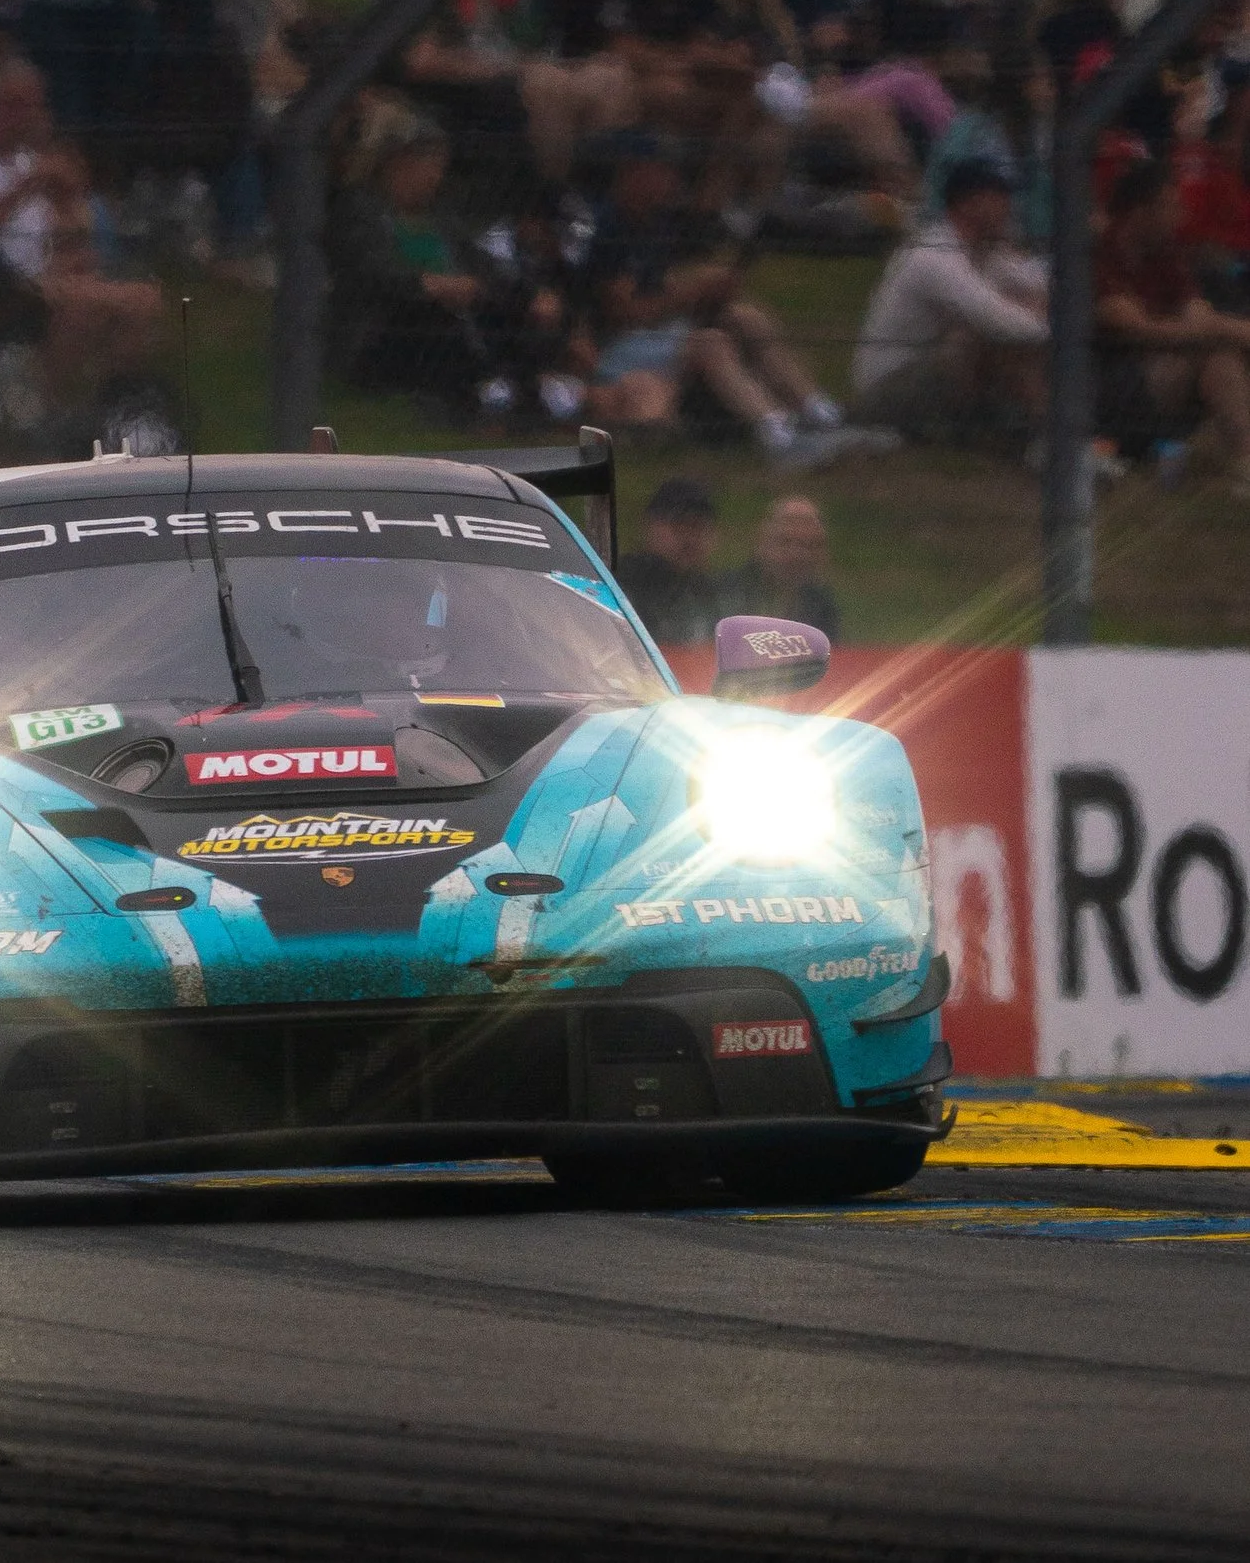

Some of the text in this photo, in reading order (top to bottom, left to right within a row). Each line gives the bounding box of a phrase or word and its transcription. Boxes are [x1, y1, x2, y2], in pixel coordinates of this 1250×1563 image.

[27, 712, 107, 741] GT3
[199, 750, 388, 779] MOTUL
[180, 831, 475, 858] MOTORSPORTS
[205, 819, 448, 842] MOUNTAIN
[616, 897, 864, 927] 1ST PHORM
[720, 1024, 808, 1054] MOTUL
